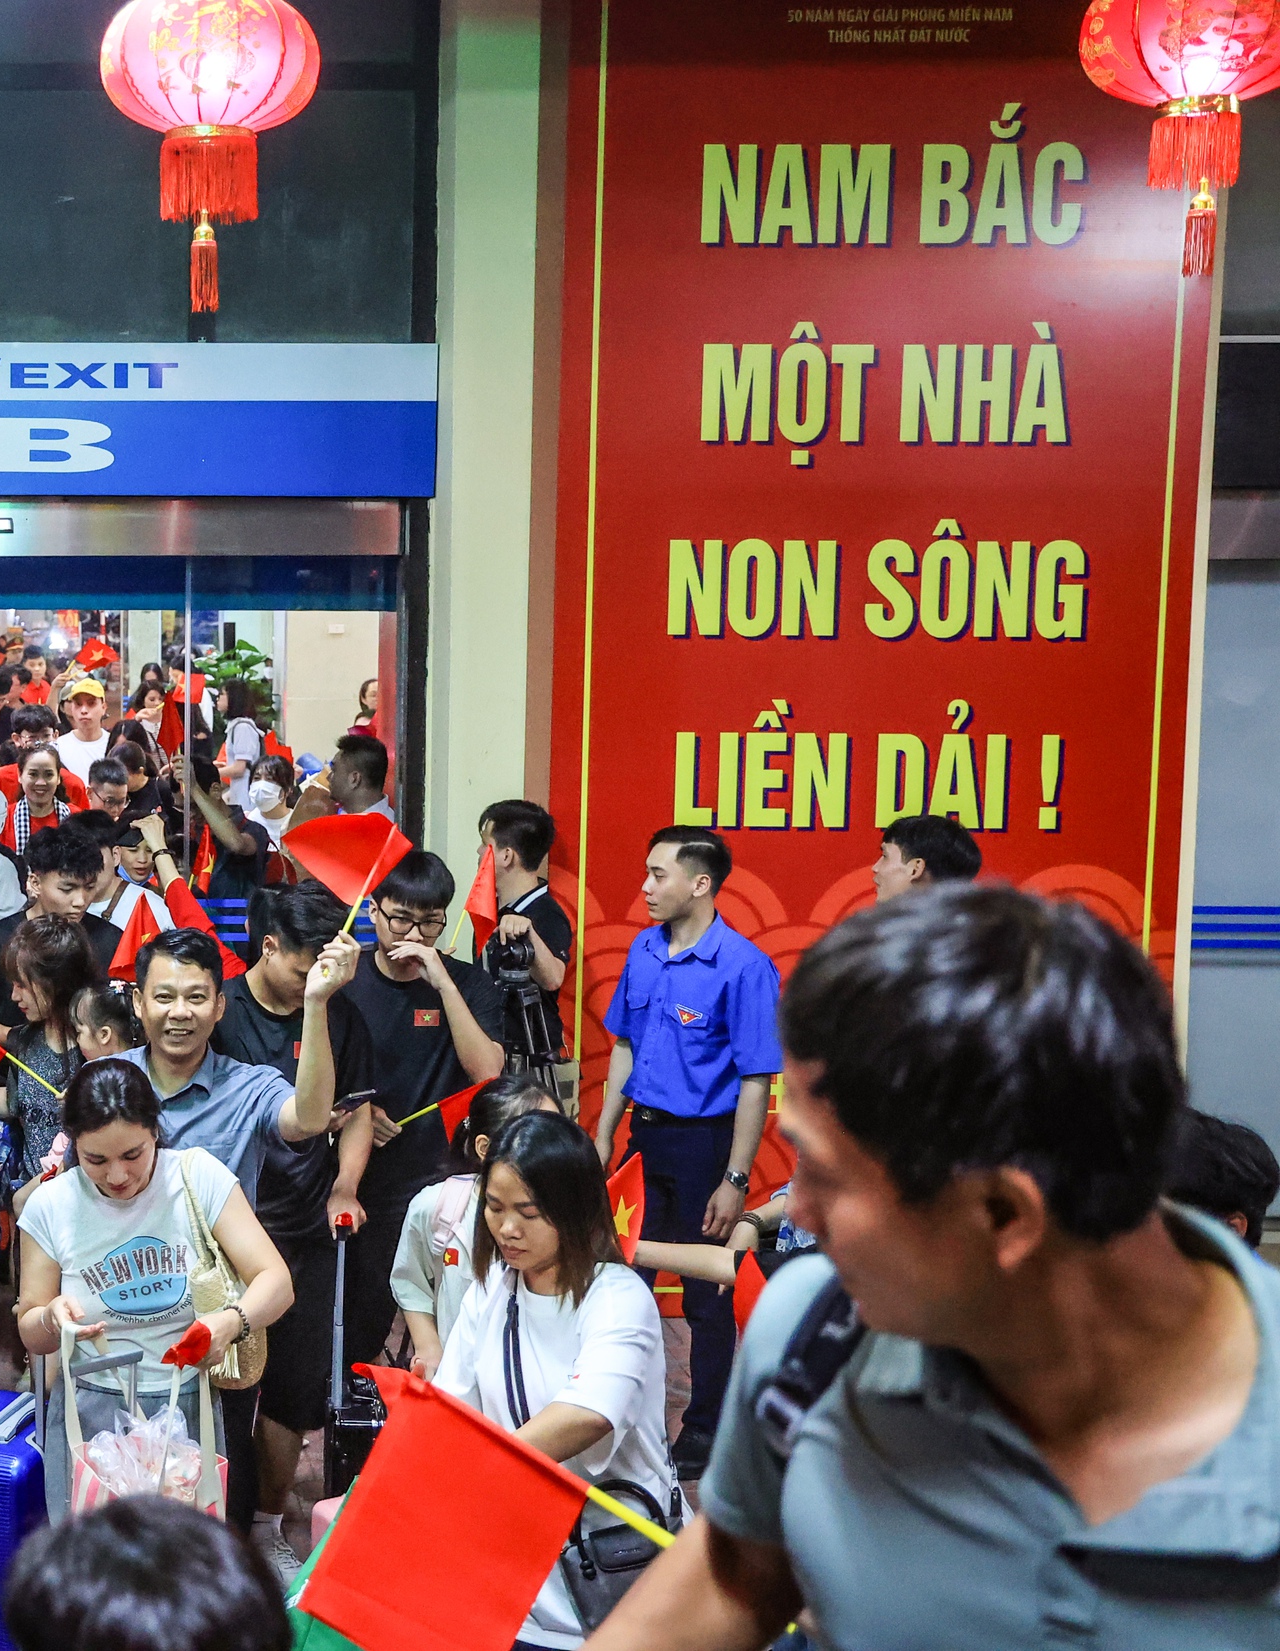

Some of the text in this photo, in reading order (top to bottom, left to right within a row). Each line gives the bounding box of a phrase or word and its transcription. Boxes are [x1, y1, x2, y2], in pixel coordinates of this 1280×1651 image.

[788, 9, 803, 22] 50
[984, 8, 1013, 21] NAM
[701, 103, 1084, 245] NAM BẮC
[701, 321, 1068, 466] MỘT NHÀ
[667, 518, 1086, 640] NON SÔNG
[673, 699, 1062, 831] LIỀN DẢI !
[79, 1244, 189, 1295] NEW YORK
[118, 1277, 173, 1301] STORY
